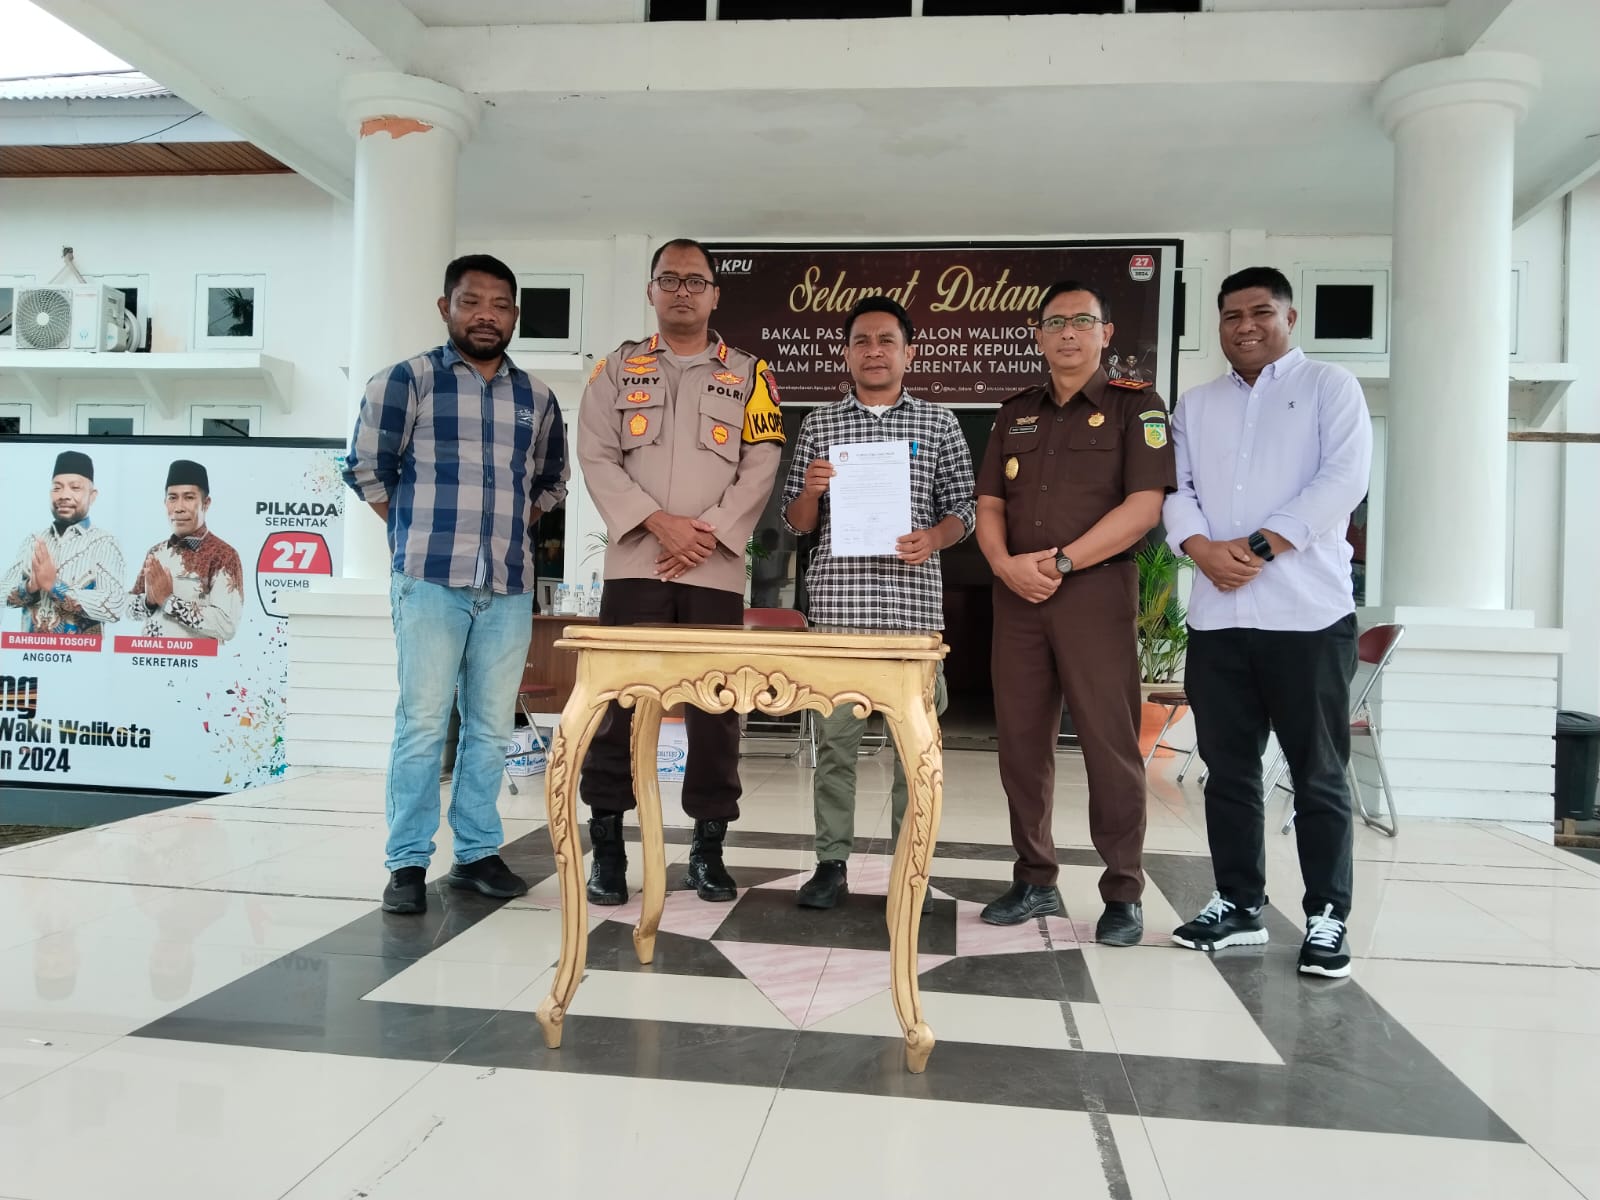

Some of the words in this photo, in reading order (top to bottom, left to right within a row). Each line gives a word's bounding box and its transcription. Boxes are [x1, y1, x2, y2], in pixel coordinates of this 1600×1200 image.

[721, 259, 753, 272] KPU
[1135, 257, 1149, 266] 27
[761, 327, 811, 340] BAKAL
[816, 327, 846, 340] PAS
[967, 327, 1037, 340] WALIKOT
[777, 343, 823, 356] WAKIL
[973, 343, 1045, 356] KEPULAU
[767, 360, 809, 373] ALAM
[904, 360, 982, 373] SERENTAK
[988, 360, 1042, 373] TAHUN
[622, 377, 660, 386] YURY
[707, 384, 744, 401] POLRI
[256, 502, 339, 516] PILKADA
[265, 517, 328, 527] SERENTAK
[273, 541, 318, 569] 27
[264, 579, 310, 588] NOVEMB
[8, 635, 57, 646] BAHRUDIN
[59, 637, 97, 647] TOSOFU
[130, 639, 164, 649] AKMAL
[167, 640, 193, 650] DAUD
[22, 652, 73, 663] ANGGOTA
[131, 656, 199, 668] SEKRETARIS
[0, 717, 52, 744] Wakil
[58, 719, 151, 749] Walikota
[18, 746, 71, 772] 2024
